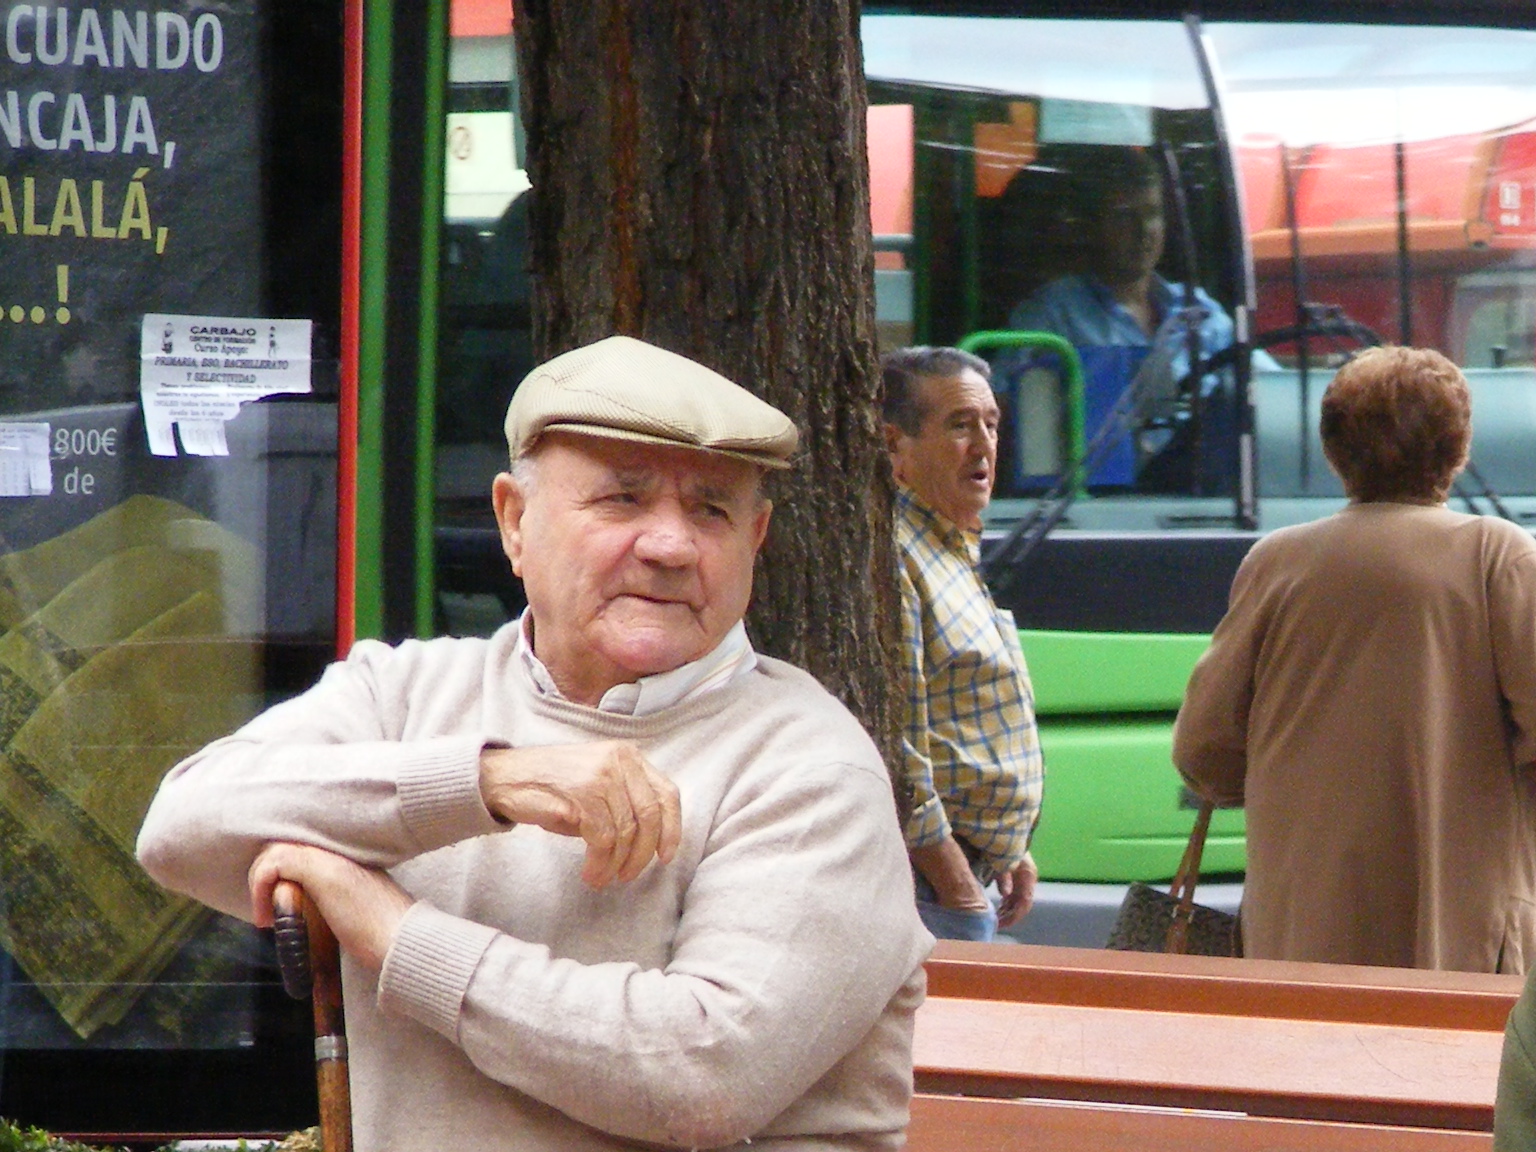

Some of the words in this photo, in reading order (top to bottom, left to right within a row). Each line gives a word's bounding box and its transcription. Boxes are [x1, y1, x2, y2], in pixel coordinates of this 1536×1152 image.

[6, 4, 224, 73] CUANDO
[190, 325, 257, 336] CARBAJO
[194, 343, 218, 353] Curso
[223, 358, 289, 370] BACHILLERATO
[194, 373, 257, 384] SELECTIVIDAD
[54, 427, 118, 456] 800€
[64, 465, 95, 495] de
